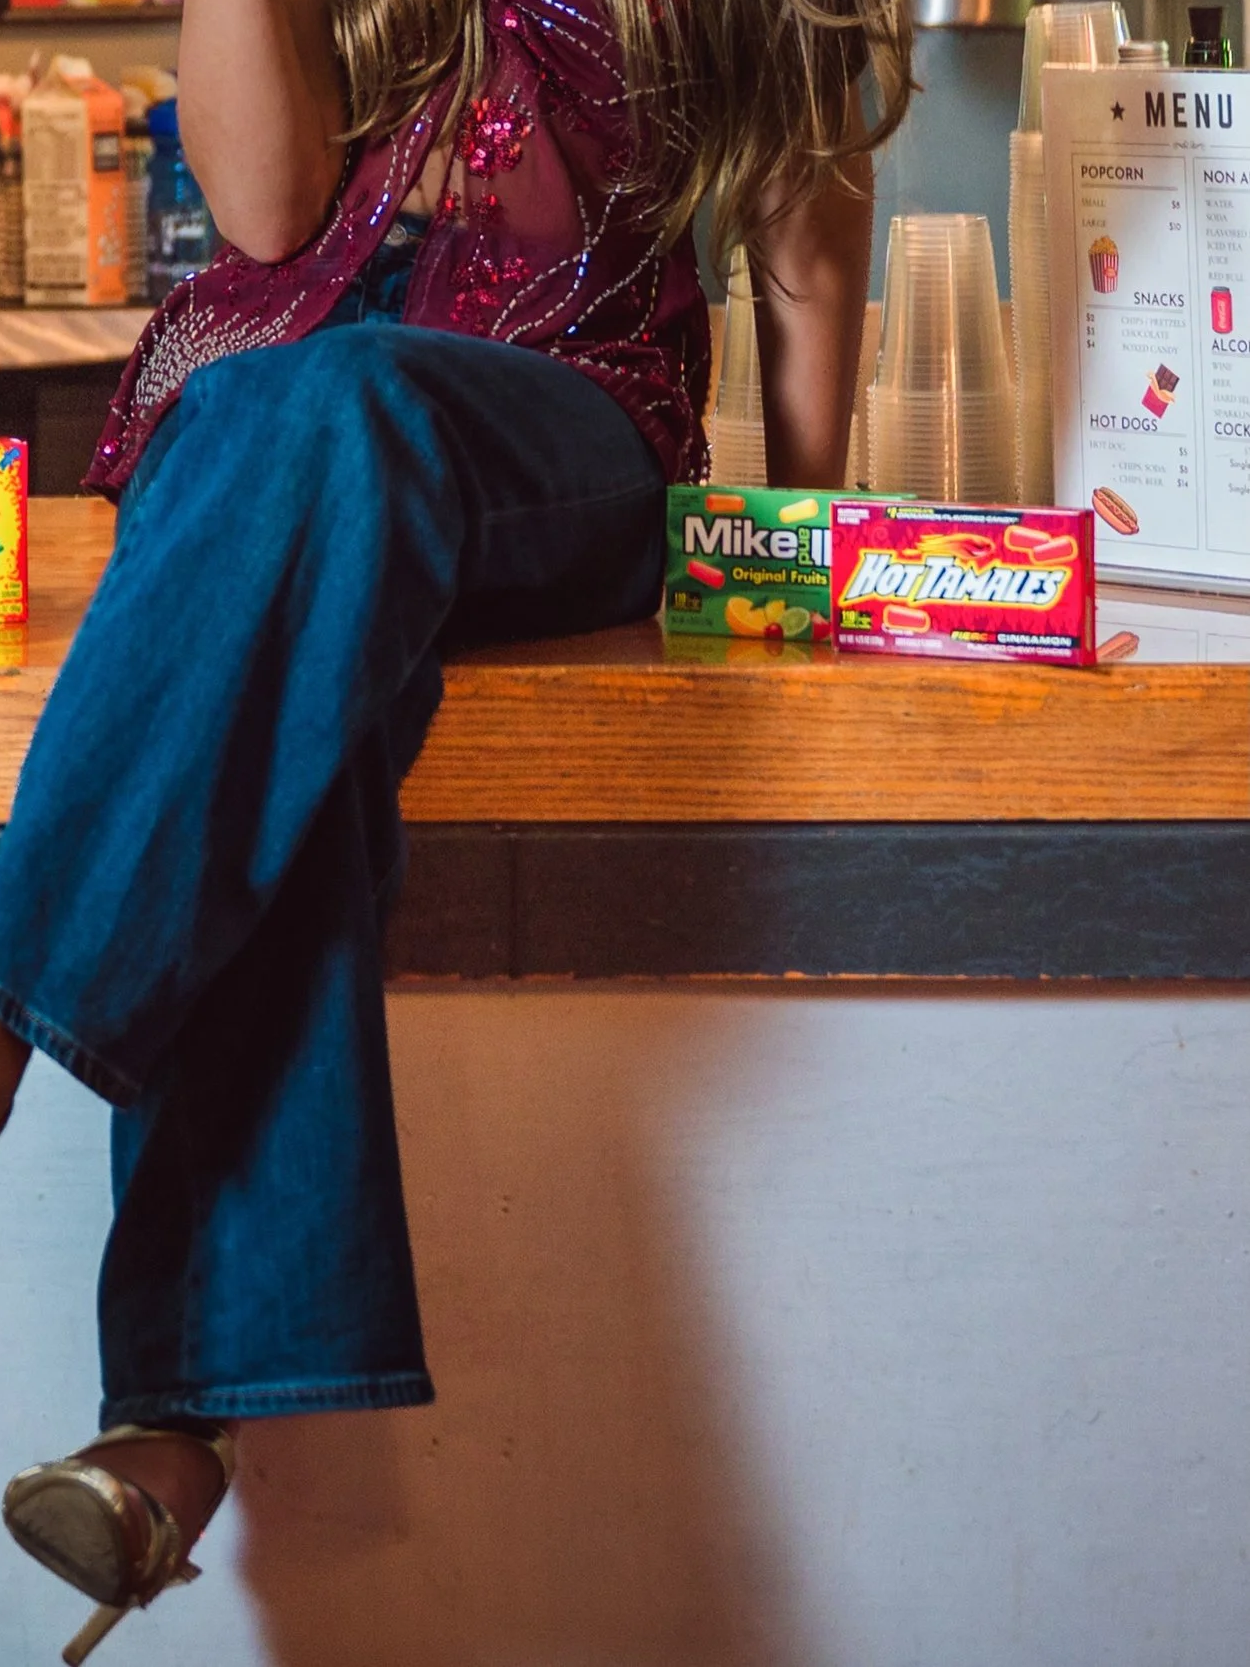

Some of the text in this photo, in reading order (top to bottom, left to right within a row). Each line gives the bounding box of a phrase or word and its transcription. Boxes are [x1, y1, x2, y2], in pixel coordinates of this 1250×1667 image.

[1144, 90, 1233, 129] MENU
[1080, 165, 1144, 181] POPCORN
[1203, 170, 1235, 184] NON
[1205, 199, 1234, 209] WATER
[1206, 214, 1228, 223] SODA
[1208, 272, 1224, 281] RED
[1133, 291, 1185, 307] SNACKS
[1211, 339, 1250, 353] ALCO
[1089, 414, 1158, 432] HOT DOGS
[684, 515, 798, 560] Mike
[797, 527, 814, 566] and
[732, 567, 828, 585] Original Fruits
[844, 552, 1067, 605] HOT TAMALES
[997, 633, 1072, 647] CINNAMON
